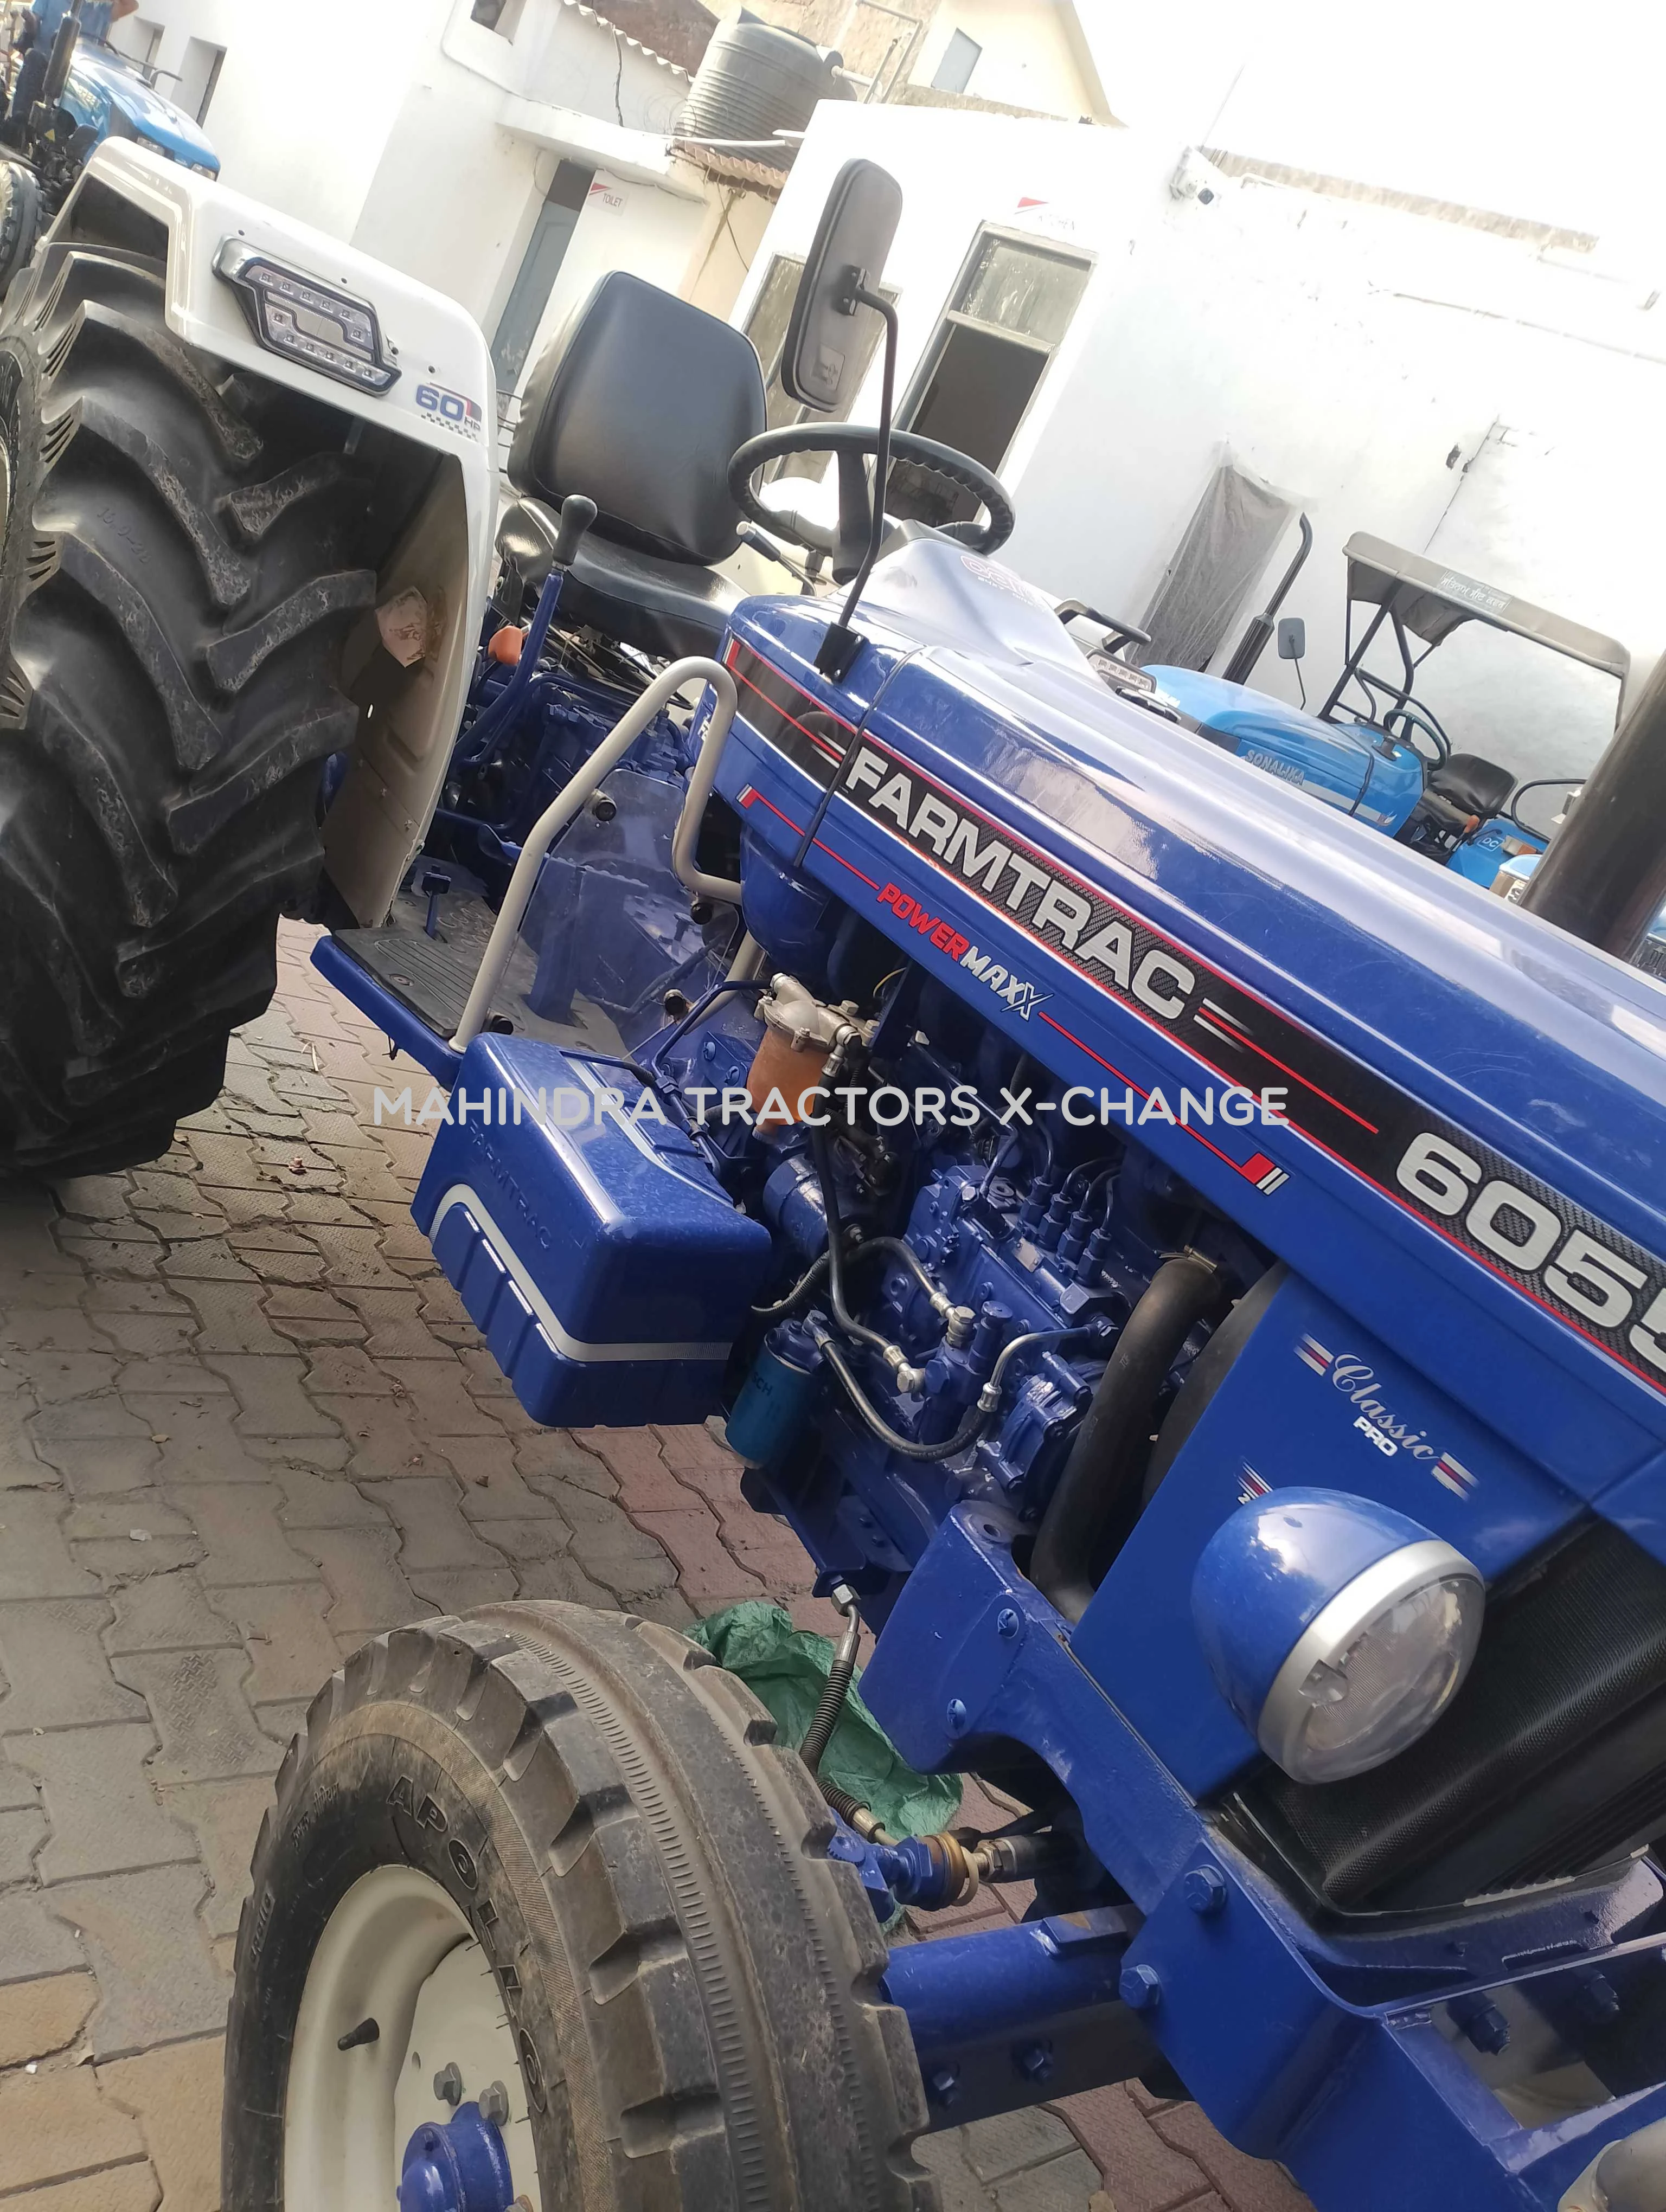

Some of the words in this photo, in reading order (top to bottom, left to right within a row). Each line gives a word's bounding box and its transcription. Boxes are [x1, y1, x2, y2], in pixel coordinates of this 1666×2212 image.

[416, 384, 464, 421] 60
[464, 416, 480, 432] HP
[1245, 749, 1305, 786] SONALIKA
[845, 745, 1195, 1020] FARMTRAC
[1332, 1354, 1440, 1459] Classic
[1353, 1416, 1398, 1457] PRO
